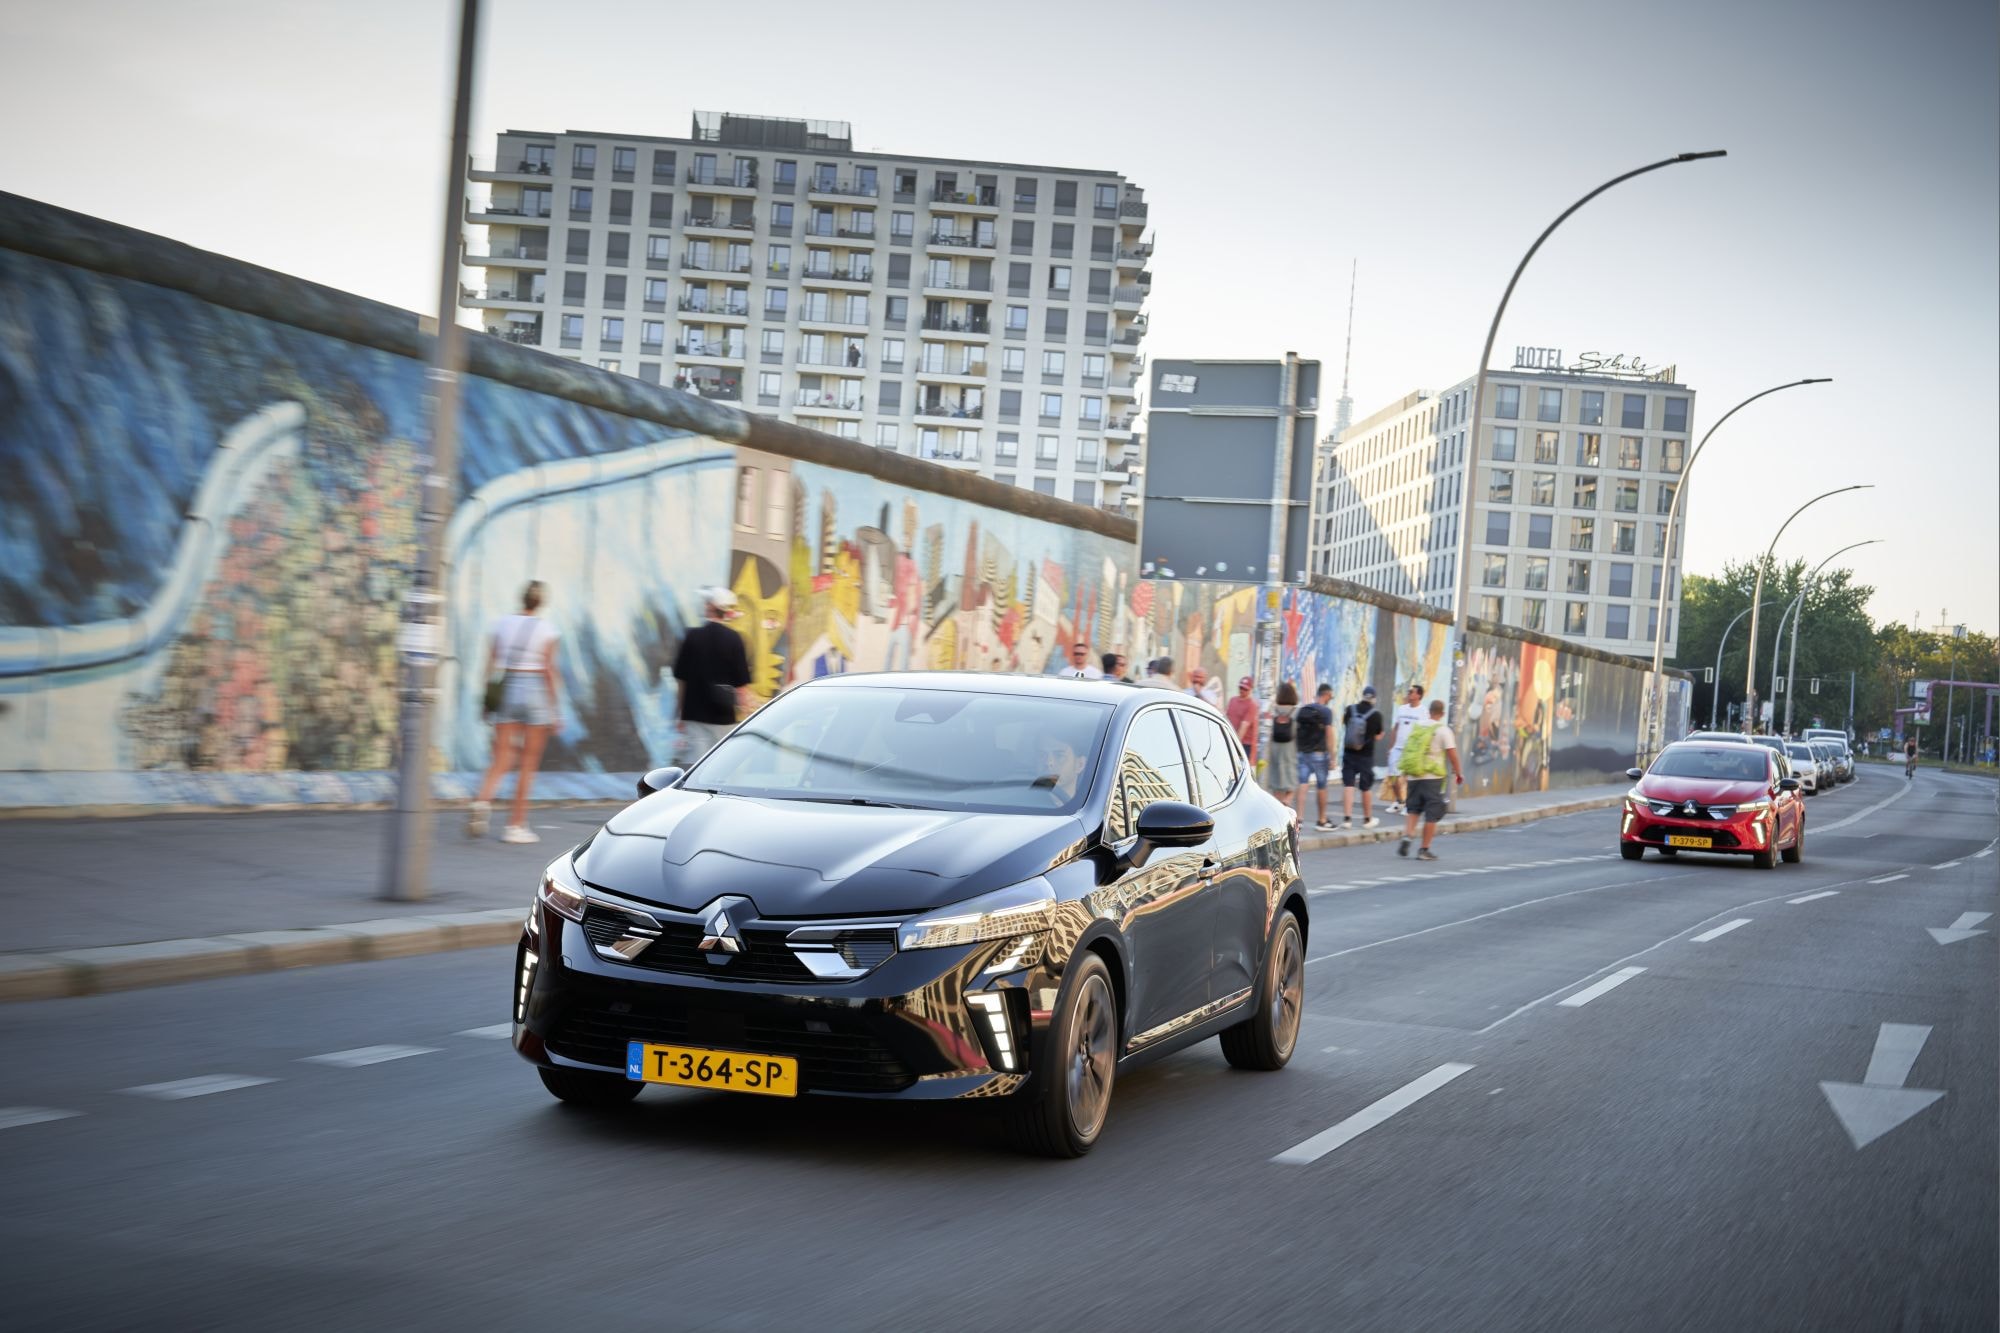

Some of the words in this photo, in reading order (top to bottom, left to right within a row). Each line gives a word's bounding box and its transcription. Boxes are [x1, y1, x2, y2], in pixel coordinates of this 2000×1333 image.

[1514, 345, 1564, 369] HOTEL
[1672, 836, 1708, 847] T-379-SP
[629, 1064, 641, 1074] NL
[652, 1050, 783, 1089] T-364-SP
